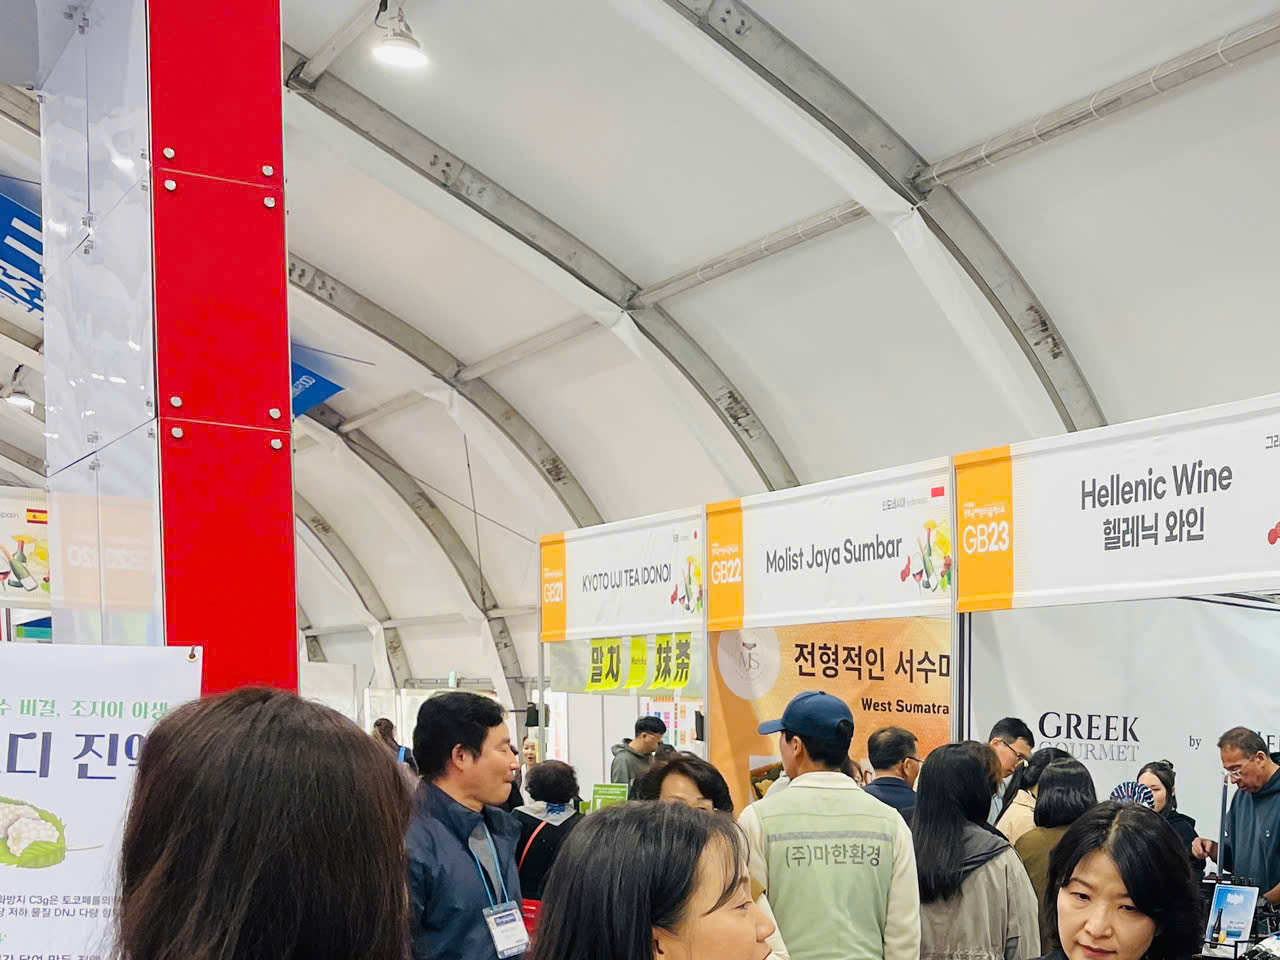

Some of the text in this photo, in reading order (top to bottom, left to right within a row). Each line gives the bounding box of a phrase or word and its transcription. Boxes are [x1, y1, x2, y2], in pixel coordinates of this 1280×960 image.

[1081, 459, 1232, 510] Hellenic Wine
[0, 511, 19, 520] pain
[1103, 506, 1205, 551] 헬레닉 와인
[963, 520, 1009, 554] GB23
[766, 546, 803, 573] Molist
[807, 543, 840, 573] Jaya
[843, 534, 902, 563] Sumbar
[583, 572, 609, 592] KYOTO
[610, 571, 623, 589] UJI
[624, 568, 640, 587] TEA
[711, 559, 742, 585] GB22
[591, 645, 620, 683] 말차
[655, 640, 690, 682] 抹茶
[793, 642, 885, 681] 전형적인
[69, 700, 124, 719] 조지아
[861, 698, 949, 715] West Sumatra
[1039, 711, 1140, 742] GREEK
[0, 732, 52, 778] 디
[1189, 736, 1201, 749] by
[785, 843, 881, 867] (주)마한환경
[54, 908, 76, 917] DNJ
